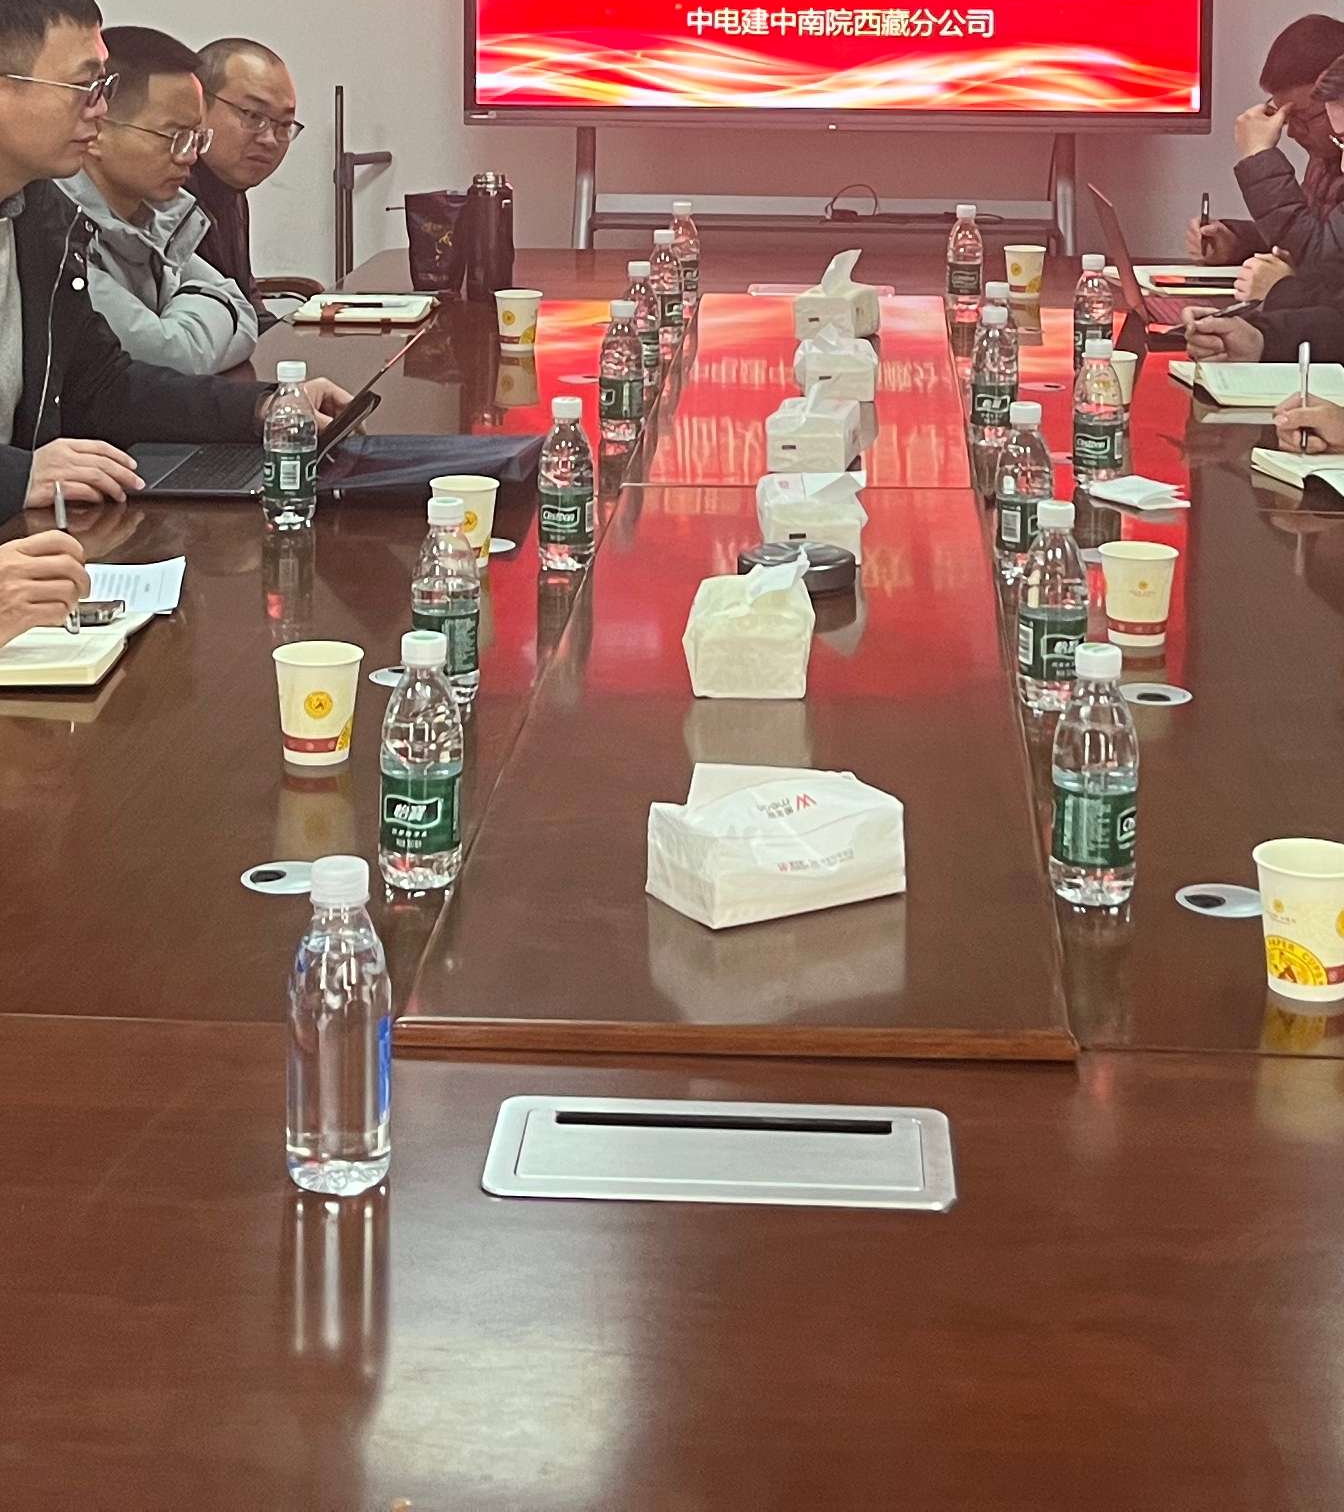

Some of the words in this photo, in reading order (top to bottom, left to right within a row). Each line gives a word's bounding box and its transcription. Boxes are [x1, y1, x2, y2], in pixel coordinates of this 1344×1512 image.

[687, 6, 994, 38] 中电建中南院西藏分公司
